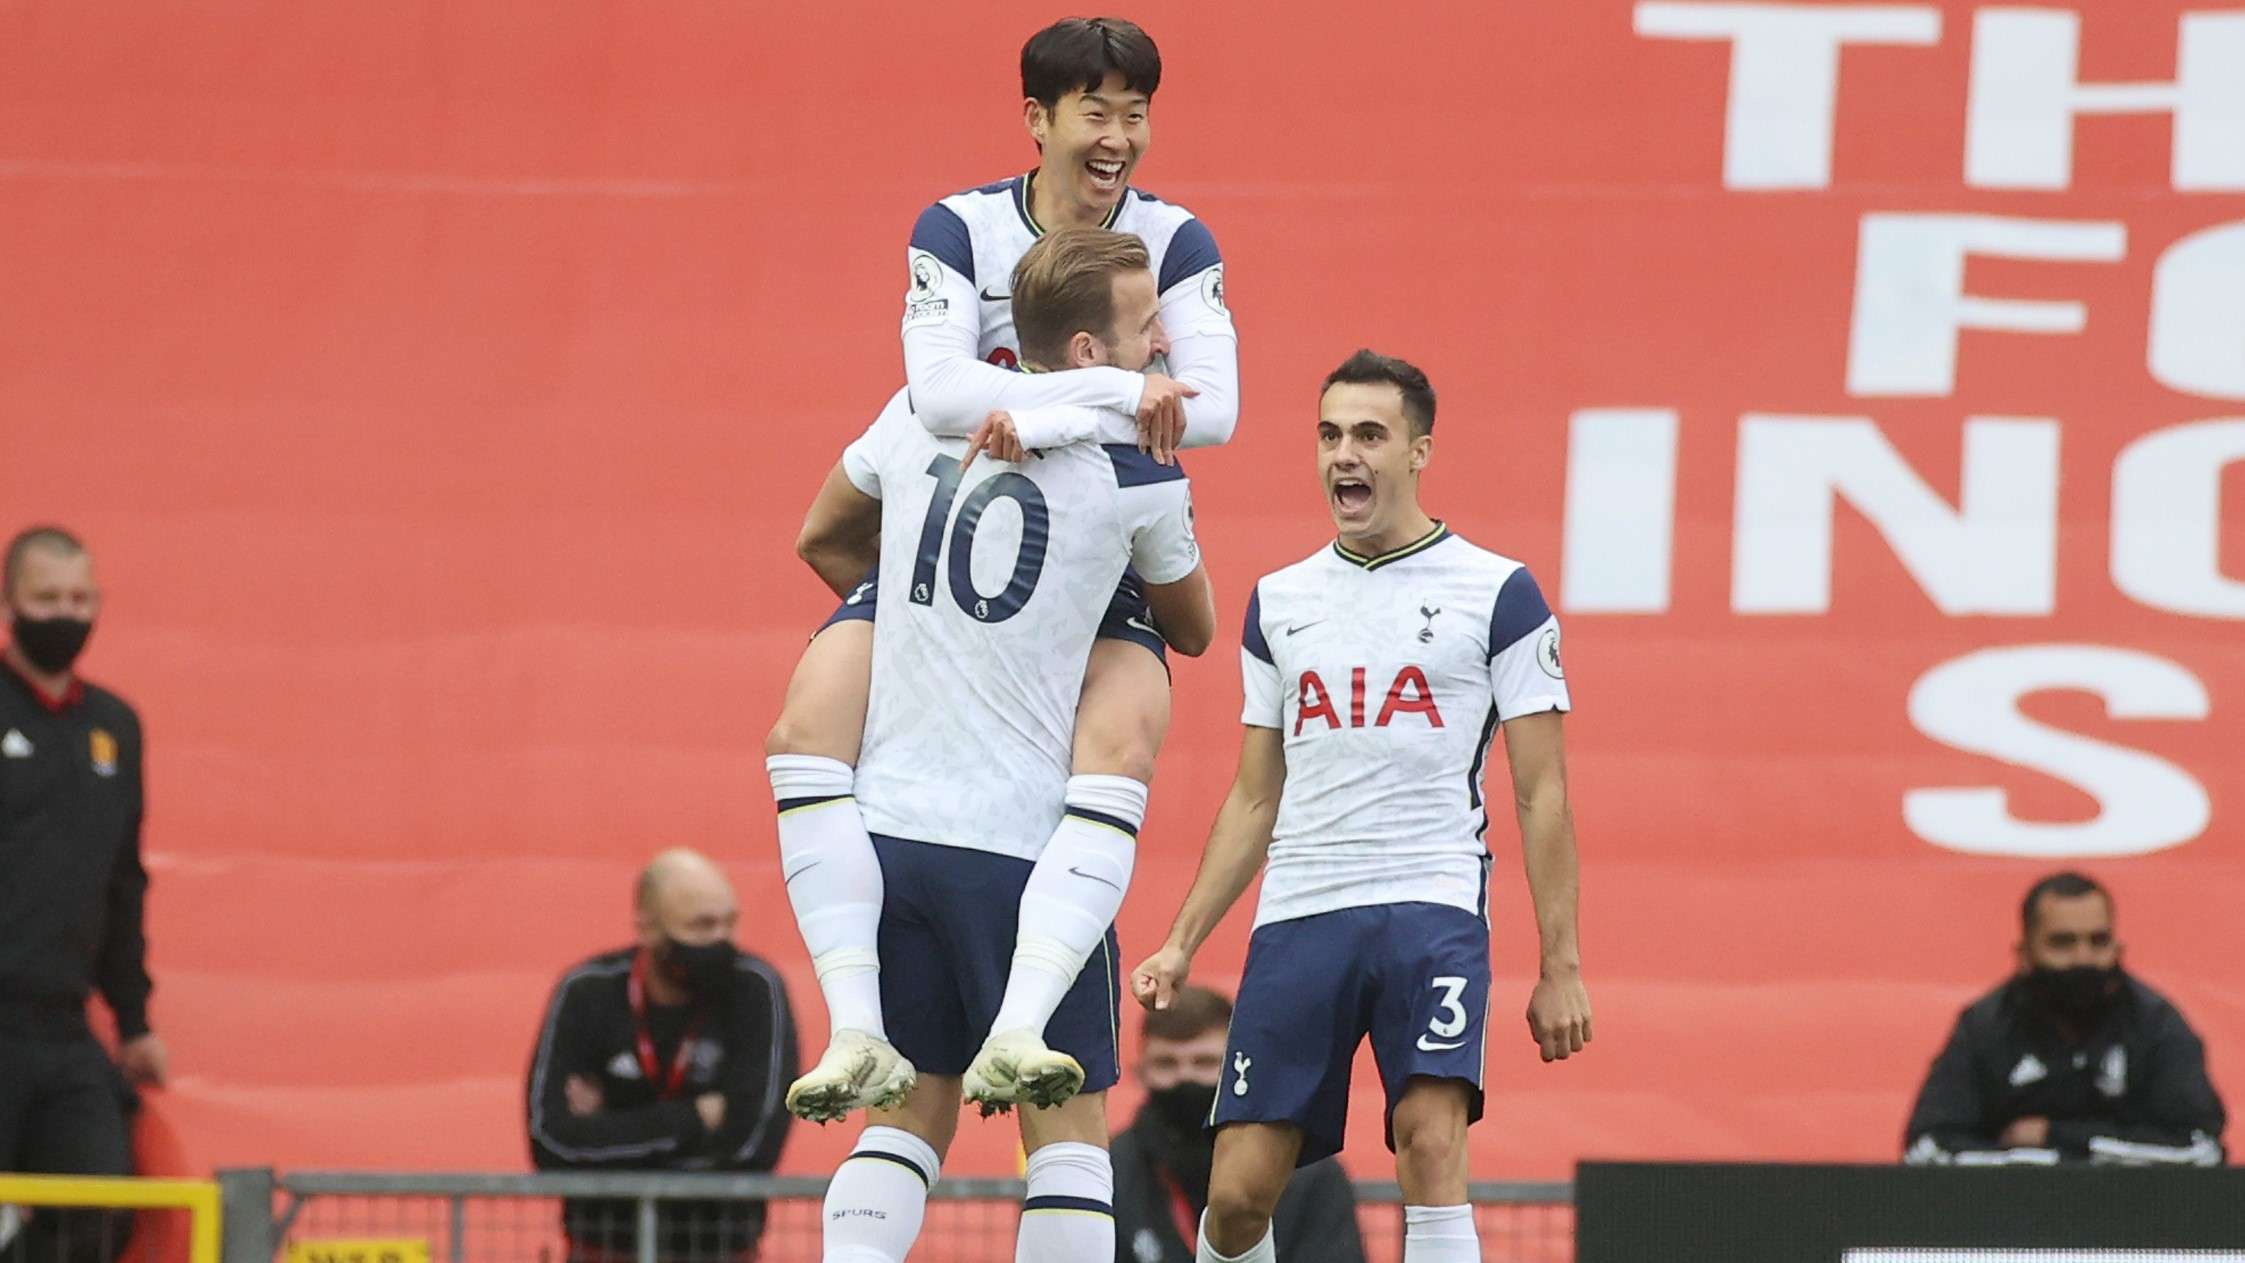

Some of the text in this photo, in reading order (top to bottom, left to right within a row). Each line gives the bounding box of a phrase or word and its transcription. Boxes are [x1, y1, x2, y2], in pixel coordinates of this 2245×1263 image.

[1634, 3, 2245, 193] TH
[909, 453, 1050, 624] 10
[1294, 665, 1446, 737] AIA
[1903, 643, 2212, 859] S
[1430, 977, 1468, 1038] 3
[832, 1209, 888, 1221] SPURS
